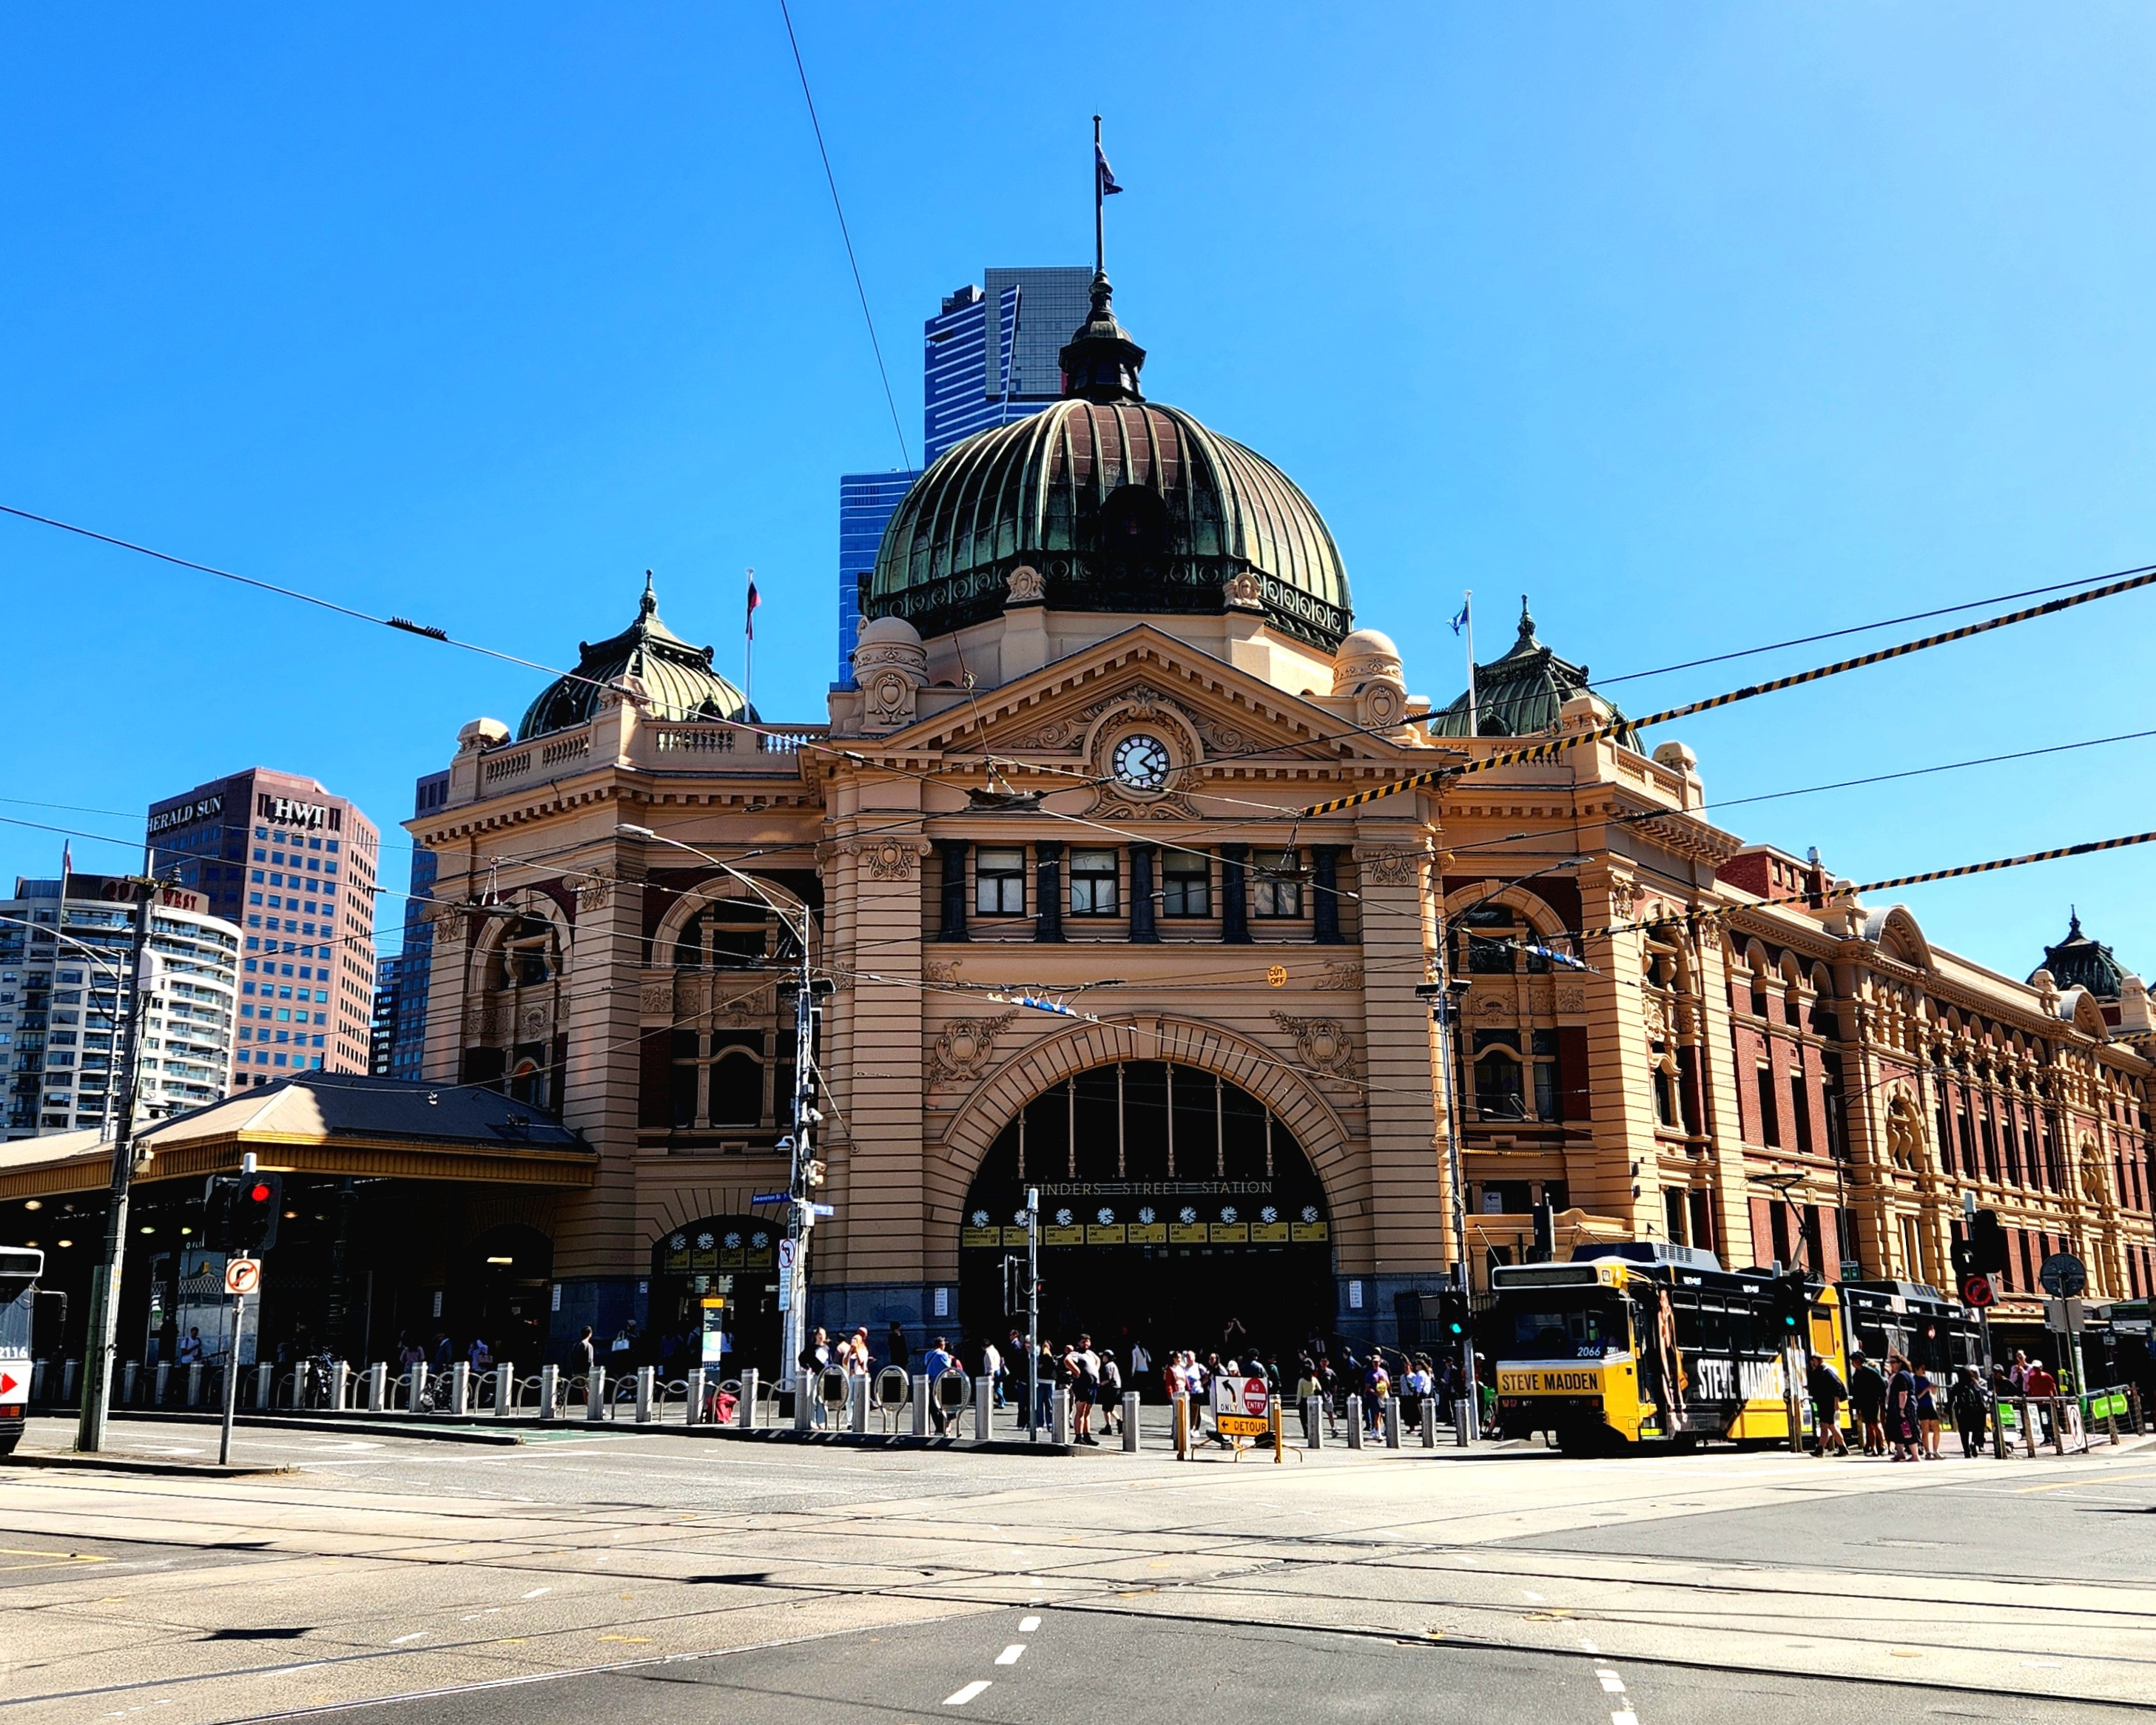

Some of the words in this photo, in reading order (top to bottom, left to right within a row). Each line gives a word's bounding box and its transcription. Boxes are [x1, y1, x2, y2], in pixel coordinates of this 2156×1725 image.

[147, 805, 193, 833] HERALD
[197, 796, 222, 817] SUN
[274, 797, 326, 824] HWT
[163, 889, 198, 911] WEST
[1023, 1183, 1101, 1195] FINDERS
[1122, 1182, 1182, 1195] STREET
[1202, 1181, 1273, 1194] STATION
[1577, 1347, 1600, 1356] 2066
[1251, 1383, 1259, 1391] NO
[1502, 1373, 1540, 1391] STEVE
[1544, 1373, 1598, 1391] MADDEN
[1697, 1359, 1736, 1400] STEVE
[1739, 1361, 1785, 1401] MADDEN
[1221, 1403, 1238, 1412] ONLY
[1247, 1401, 1264, 1410] ENTRY
[1234, 1420, 1267, 1433] DETOUR
